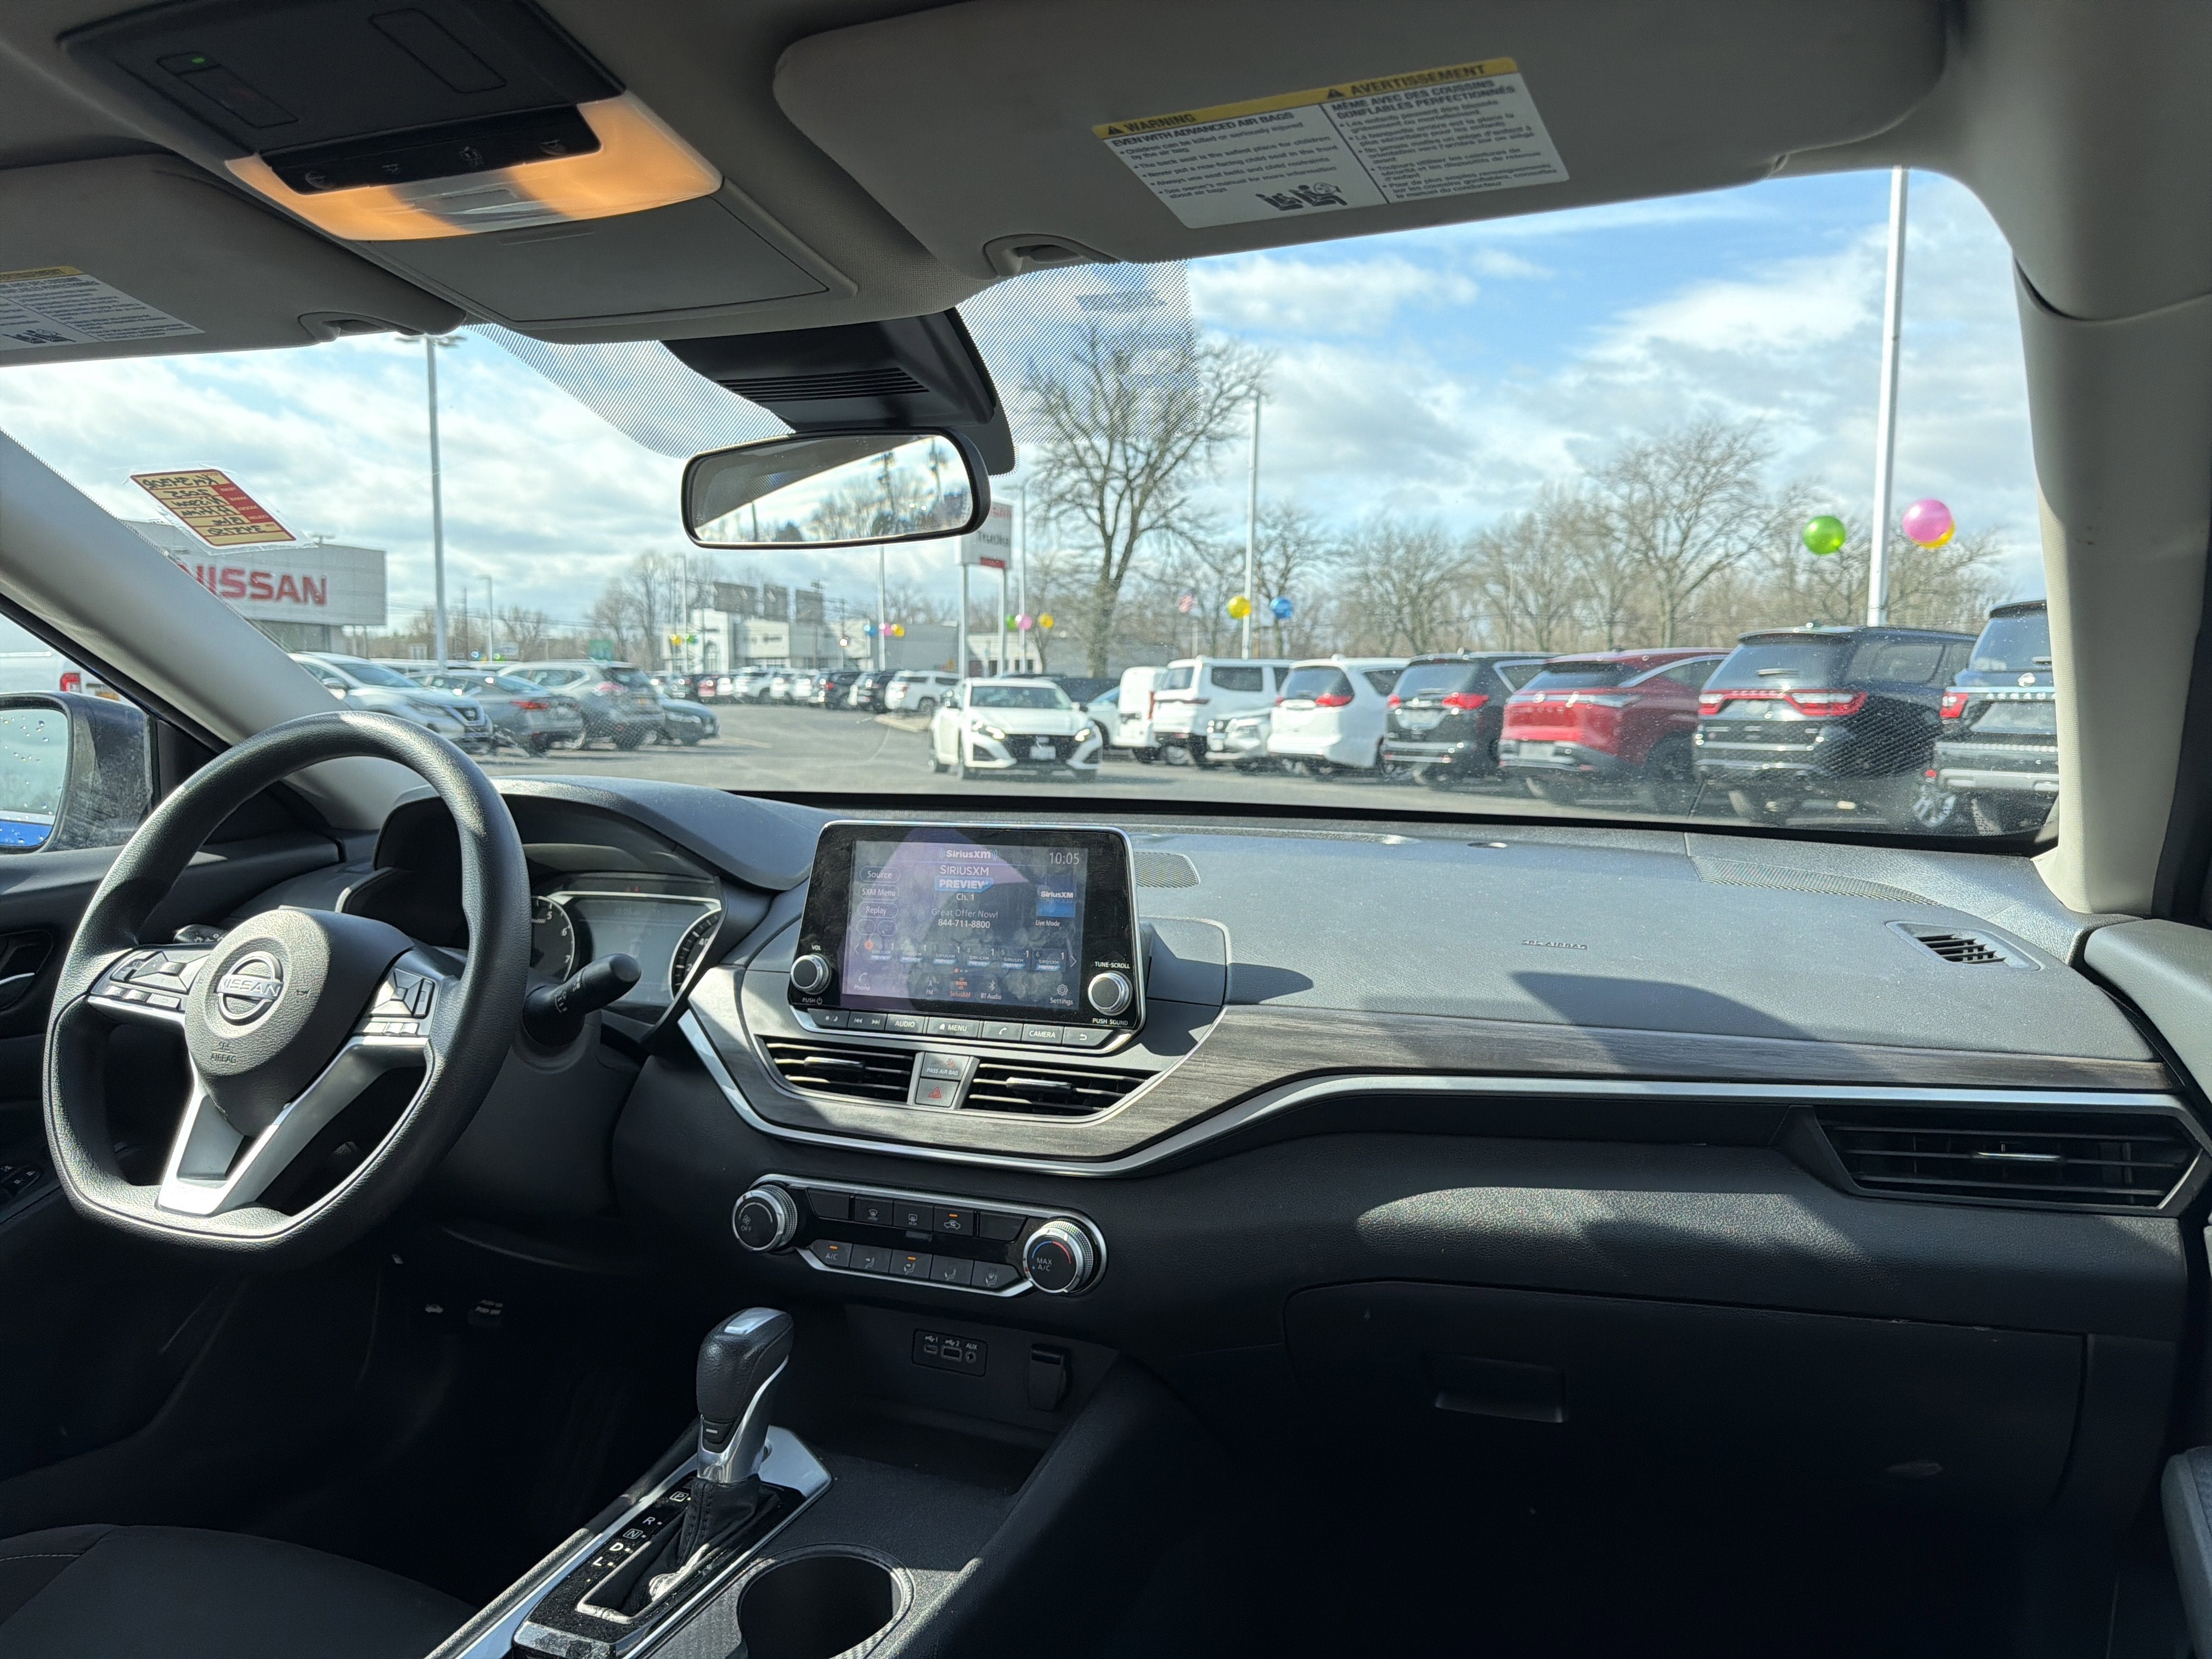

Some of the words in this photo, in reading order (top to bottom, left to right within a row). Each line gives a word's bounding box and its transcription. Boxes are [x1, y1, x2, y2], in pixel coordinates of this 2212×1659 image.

[1351, 64, 1483, 94] AVERTISSEMENT
[1124, 114, 1196, 132] WARNING
[1112, 137, 1143, 146] EVEN
[1143, 132, 1173, 142] WITH
[1173, 122, 1236, 137] ADVANCED
[1238, 119, 1258, 127] AIR
[1259, 112, 1294, 123] BAGS
[1049, 852, 1080, 865] 10:05
[940, 865, 989, 876] SIRIUSXM
[939, 879, 989, 889] PREVIEW
[547, 911, 552, 919] 5
[866, 906, 887, 915] Replay
[955, 909, 975, 917] Offer
[978, 910, 998, 918] Now!
[938, 919, 990, 928] 844-711-8800
[562, 928, 567, 936] 6
[565, 955, 571, 963] 7
[221, 978, 280, 996] NISSAN
[642, 1516, 656, 1525] R
[610, 1543, 623, 1551] D
[592, 1556, 603, 1566] L
